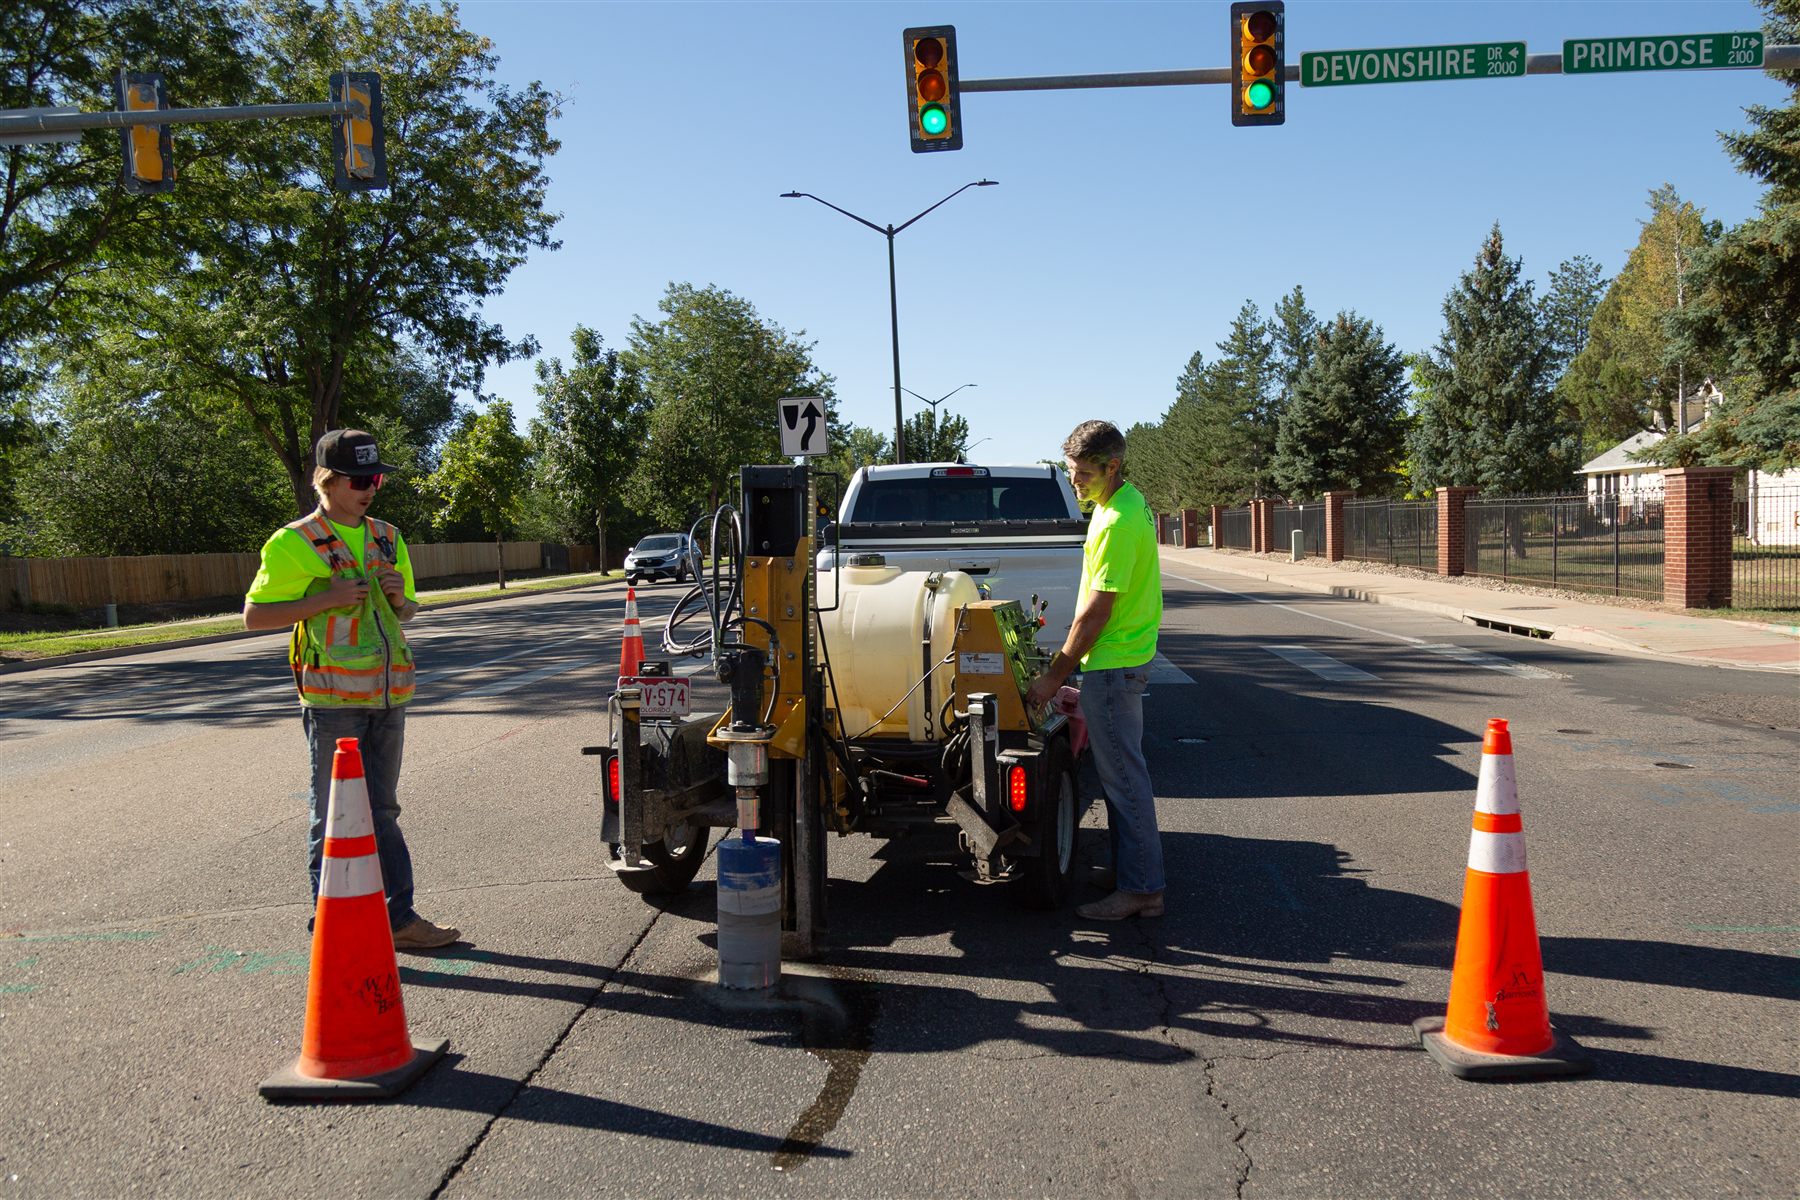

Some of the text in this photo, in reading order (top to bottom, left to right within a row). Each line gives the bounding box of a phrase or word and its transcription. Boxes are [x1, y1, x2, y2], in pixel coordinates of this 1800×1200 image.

[1573, 35, 1748, 69] PRIMROSE Dr
[1727, 50, 1755, 65] 2100
[1312, 47, 1503, 82] DEVONSHIRE DR
[1487, 61, 1517, 75] 2000
[639, 688, 686, 706] V·S74
